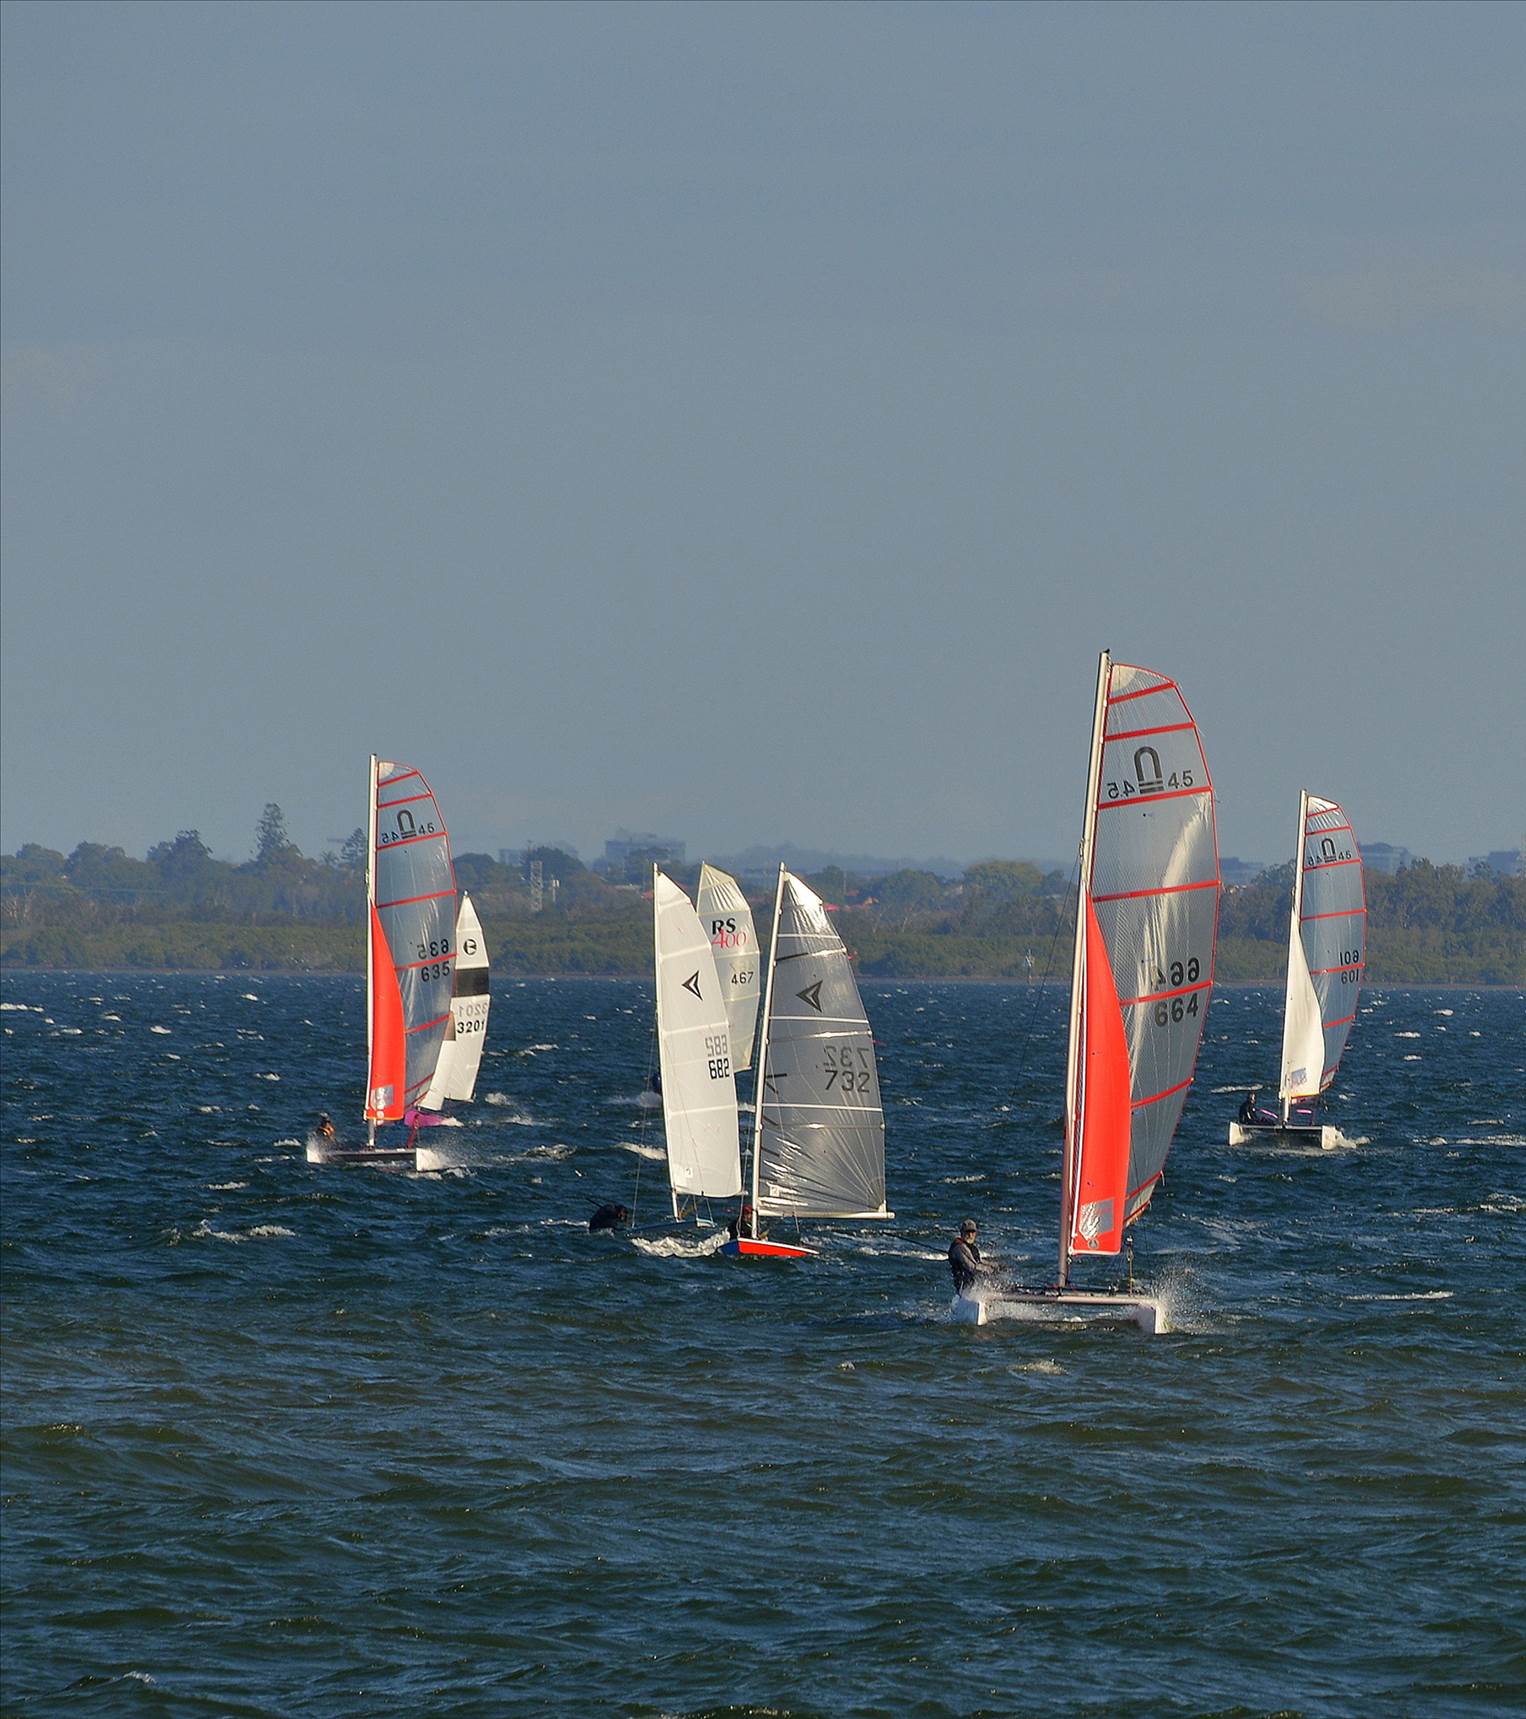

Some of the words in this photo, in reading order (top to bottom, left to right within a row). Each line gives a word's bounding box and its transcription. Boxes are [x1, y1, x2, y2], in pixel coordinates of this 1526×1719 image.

[1168, 769, 1194, 789] 4.5
[711, 917, 737, 935] RS
[711, 928, 747, 949] 400
[421, 961, 450, 982] 635
[731, 971, 754, 985] 467
[1341, 968, 1359, 985] 601
[1154, 993, 1199, 1027] 664
[456, 1020, 485, 1034] 3201
[708, 1058, 730, 1080] 682
[825, 1069, 870, 1093] 732
